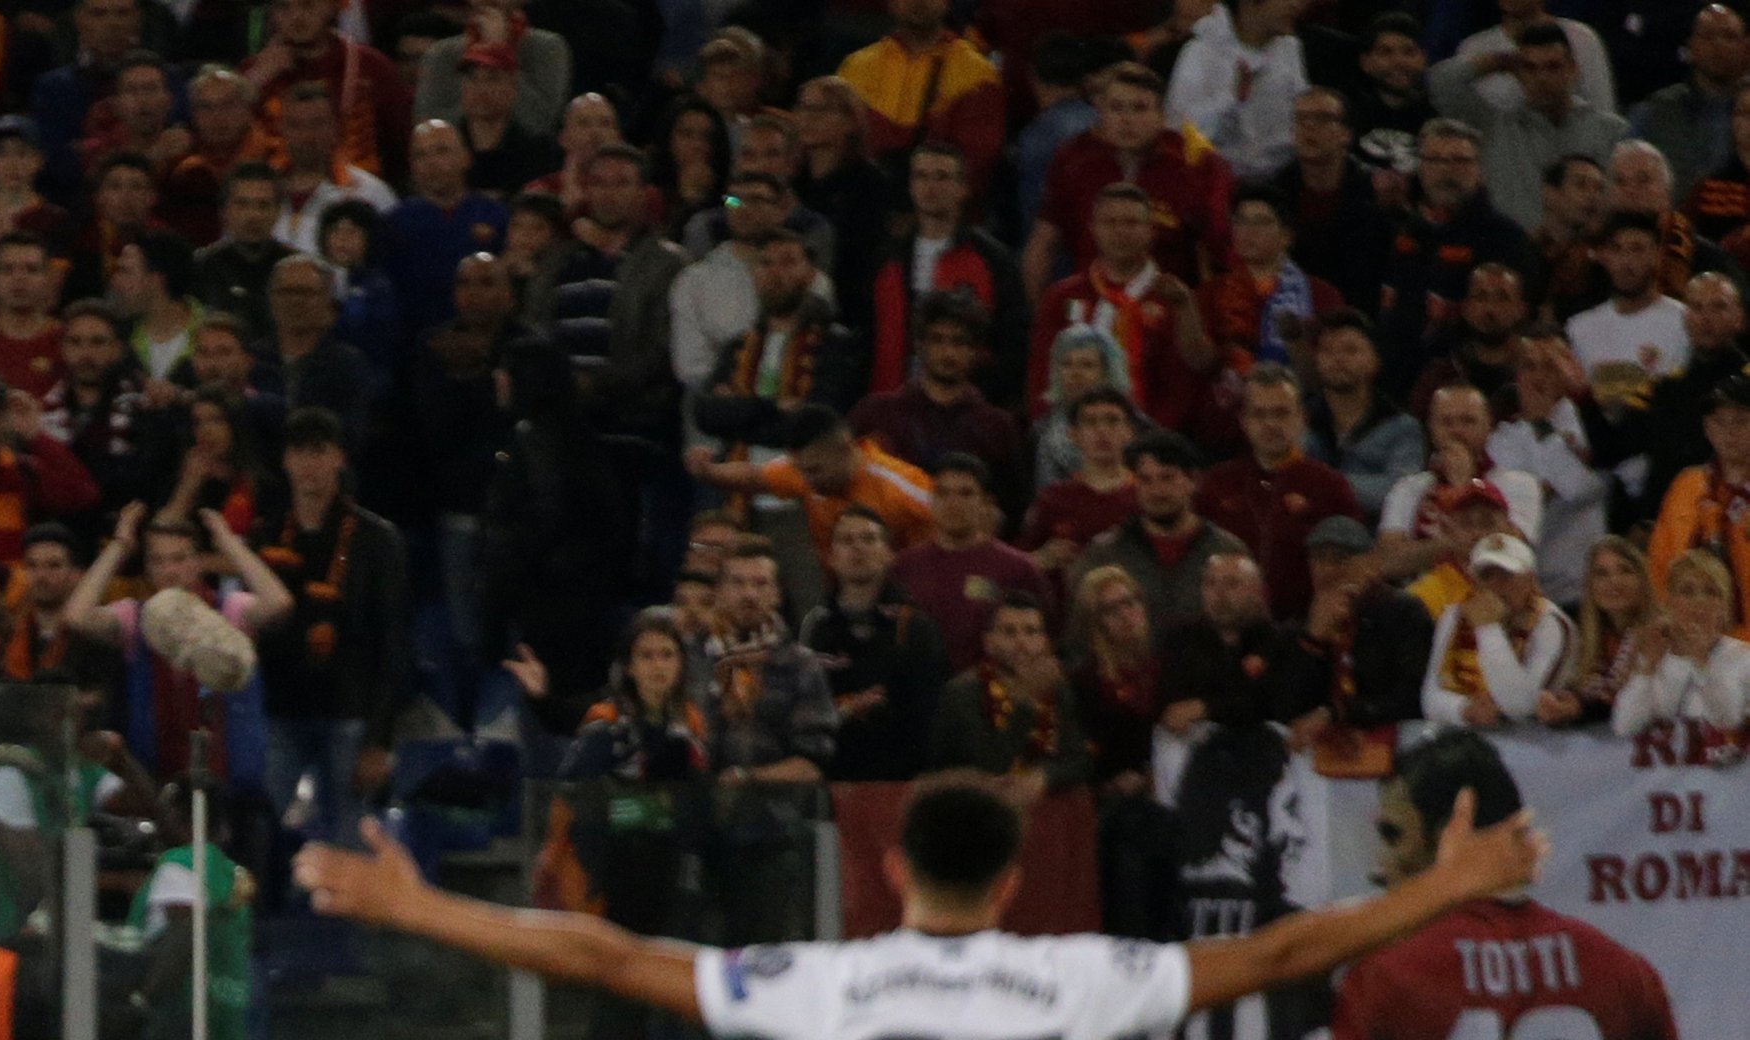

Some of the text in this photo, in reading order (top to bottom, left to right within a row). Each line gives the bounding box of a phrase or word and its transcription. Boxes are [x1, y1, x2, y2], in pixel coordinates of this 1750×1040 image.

[1648, 791, 1707, 834] DI
[1584, 846, 1750, 904] ROMA
[1453, 933, 1582, 998] TOTTI
